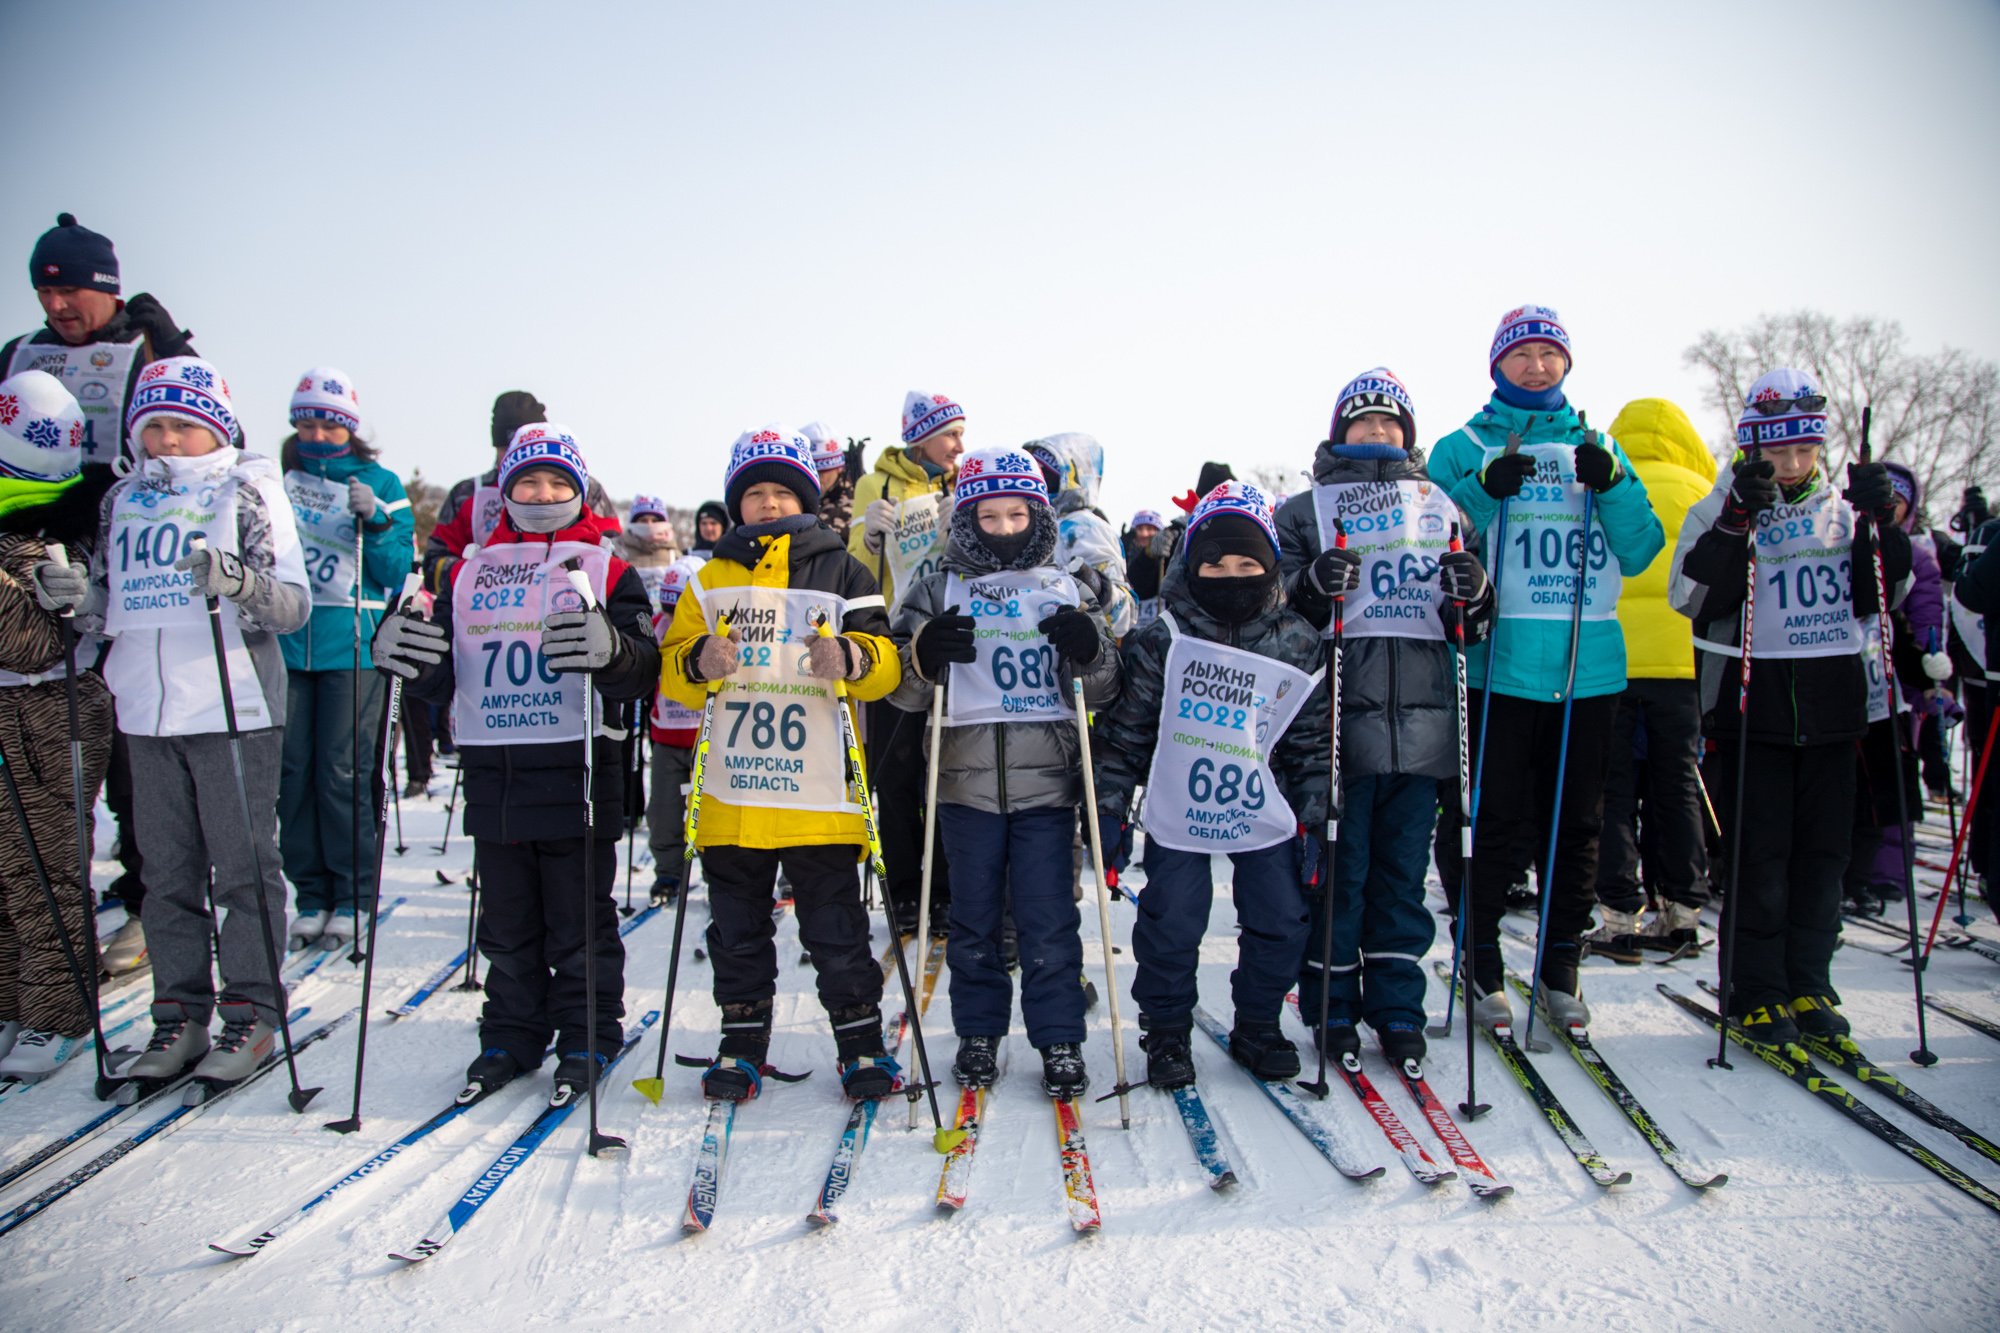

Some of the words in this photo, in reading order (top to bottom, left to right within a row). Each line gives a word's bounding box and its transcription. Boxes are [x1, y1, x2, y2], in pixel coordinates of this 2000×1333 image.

[1335, 480, 1399, 505] ЛЫЖНЯ
[1337, 492, 1403, 518] РОССИИ
[1508, 486, 1564, 502] 022
[894, 519, 935, 542] РОССИИ
[1343, 508, 1405, 536] 2022
[1757, 519, 1815, 547] 2022
[1515, 527, 1608, 571] 1069
[122, 572, 194, 593] АМУРСКАЯ
[474, 571, 535, 590] РОССИИ
[124, 592, 190, 612] ОБЛАСТЬ
[470, 587, 526, 611] 2022
[1531, 592, 1593, 606] ОБЛАСЬ
[1363, 605, 1426, 620] ОБЛАСТЬ
[1784, 609, 1849, 629] АМУРСКАЯ
[1872, 553, 1893, 675] MADSHUS
[1788, 628, 1849, 646] ОБЛАСТЬ
[1183, 660, 1257, 690] ЛЫЖНЯ
[391, 677, 402, 719] NORDW
[480, 691, 562, 710] АМУРСКАЯ
[747, 681, 789, 695] НОРМА
[790, 684, 828, 699] ЖИЗНИ
[1181, 677, 1253, 708] РОССИИ
[485, 712, 560, 729] ОБЛАСТЬ
[703, 703, 715, 738] STC
[725, 701, 807, 752] 786
[1177, 698, 1248, 731] 2022
[1457, 657, 1470, 796] MADSHUS
[1173, 732, 1207, 749] СПОРТ
[724, 755, 804, 774] АМУРСКАЯ
[840, 710, 855, 748] STC
[852, 760, 877, 842] SPORTER
[691, 751, 708, 830] SPORTER
[730, 775, 800, 793] ОБЛАСТЬ
[1188, 757, 1265, 811] 689
[1188, 820, 1251, 841] ОБЛАСТЬ
[1367, 1101, 1419, 1150] NORDWA
[1427, 1109, 1480, 1163] NORDWAY
[462, 1146, 529, 1206] NORDWAY
